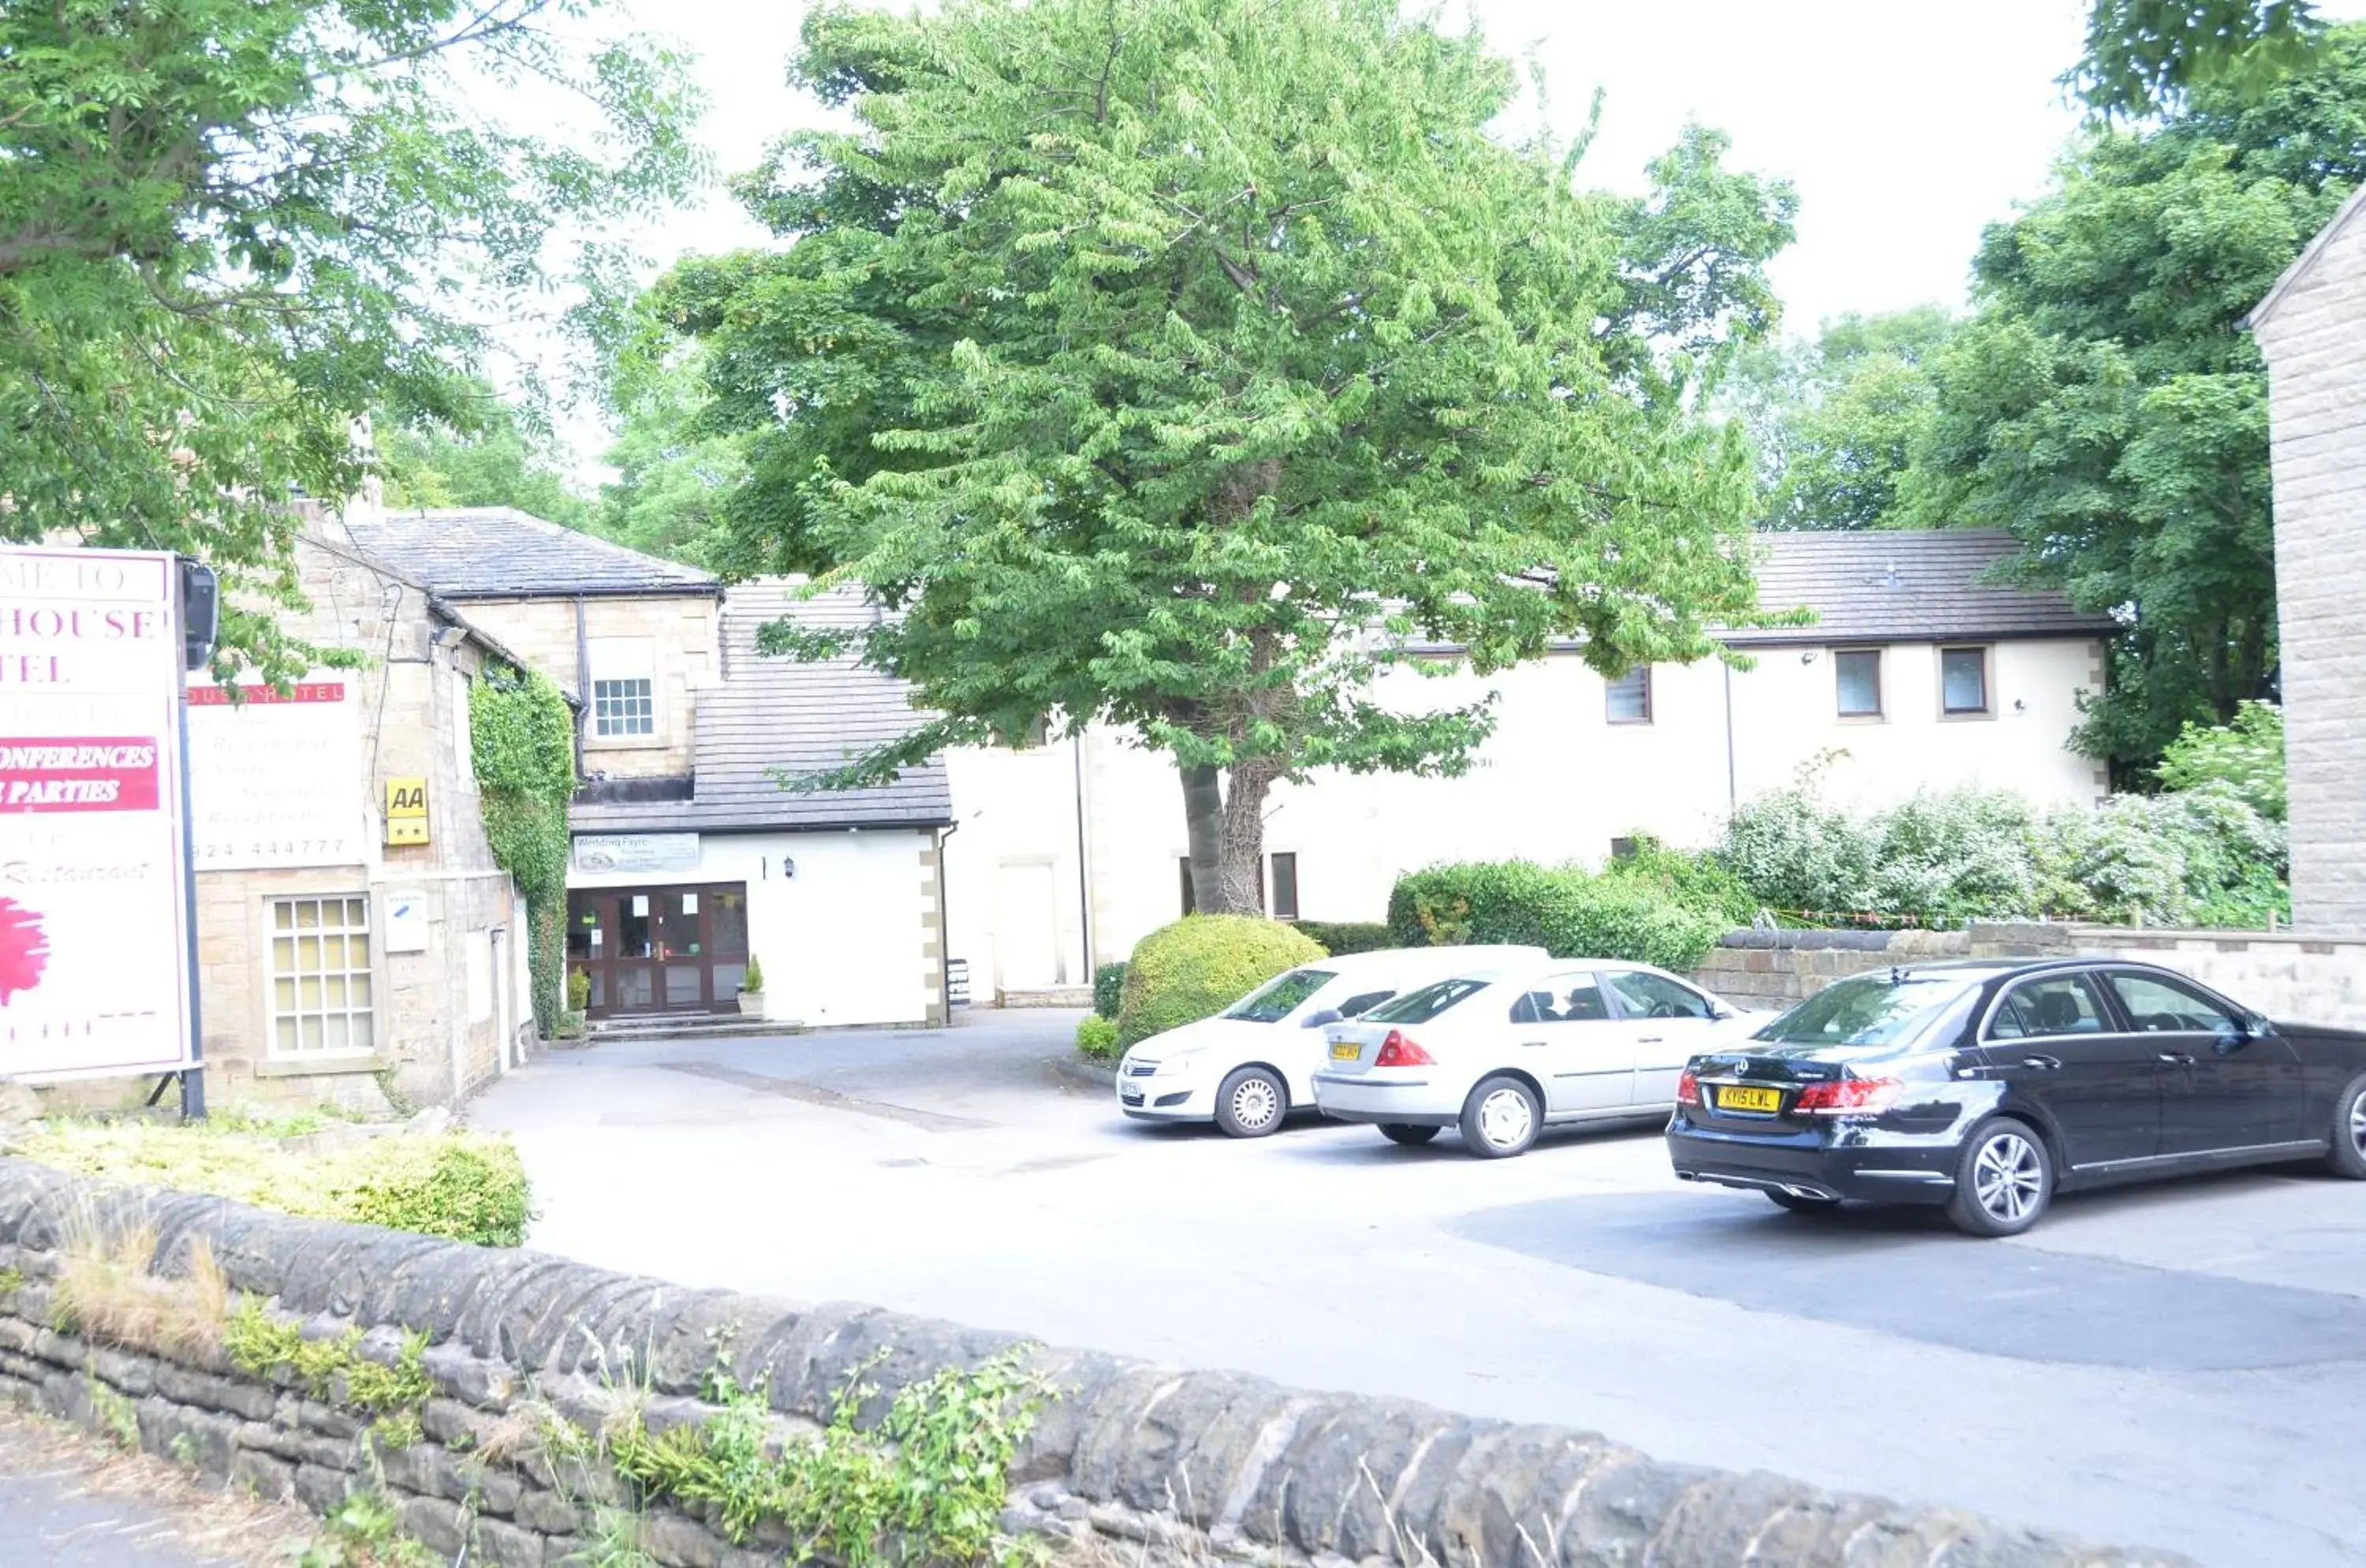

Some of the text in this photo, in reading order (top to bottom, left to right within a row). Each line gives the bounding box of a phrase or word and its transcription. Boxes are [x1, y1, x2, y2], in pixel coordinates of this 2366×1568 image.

[73, 562, 125, 590] TO
[0, 607, 155, 641] HOUSE
[7, 780, 120, 804] PARTIES
[392, 787, 424, 808] AA
[251, 838, 344, 856] 444777
